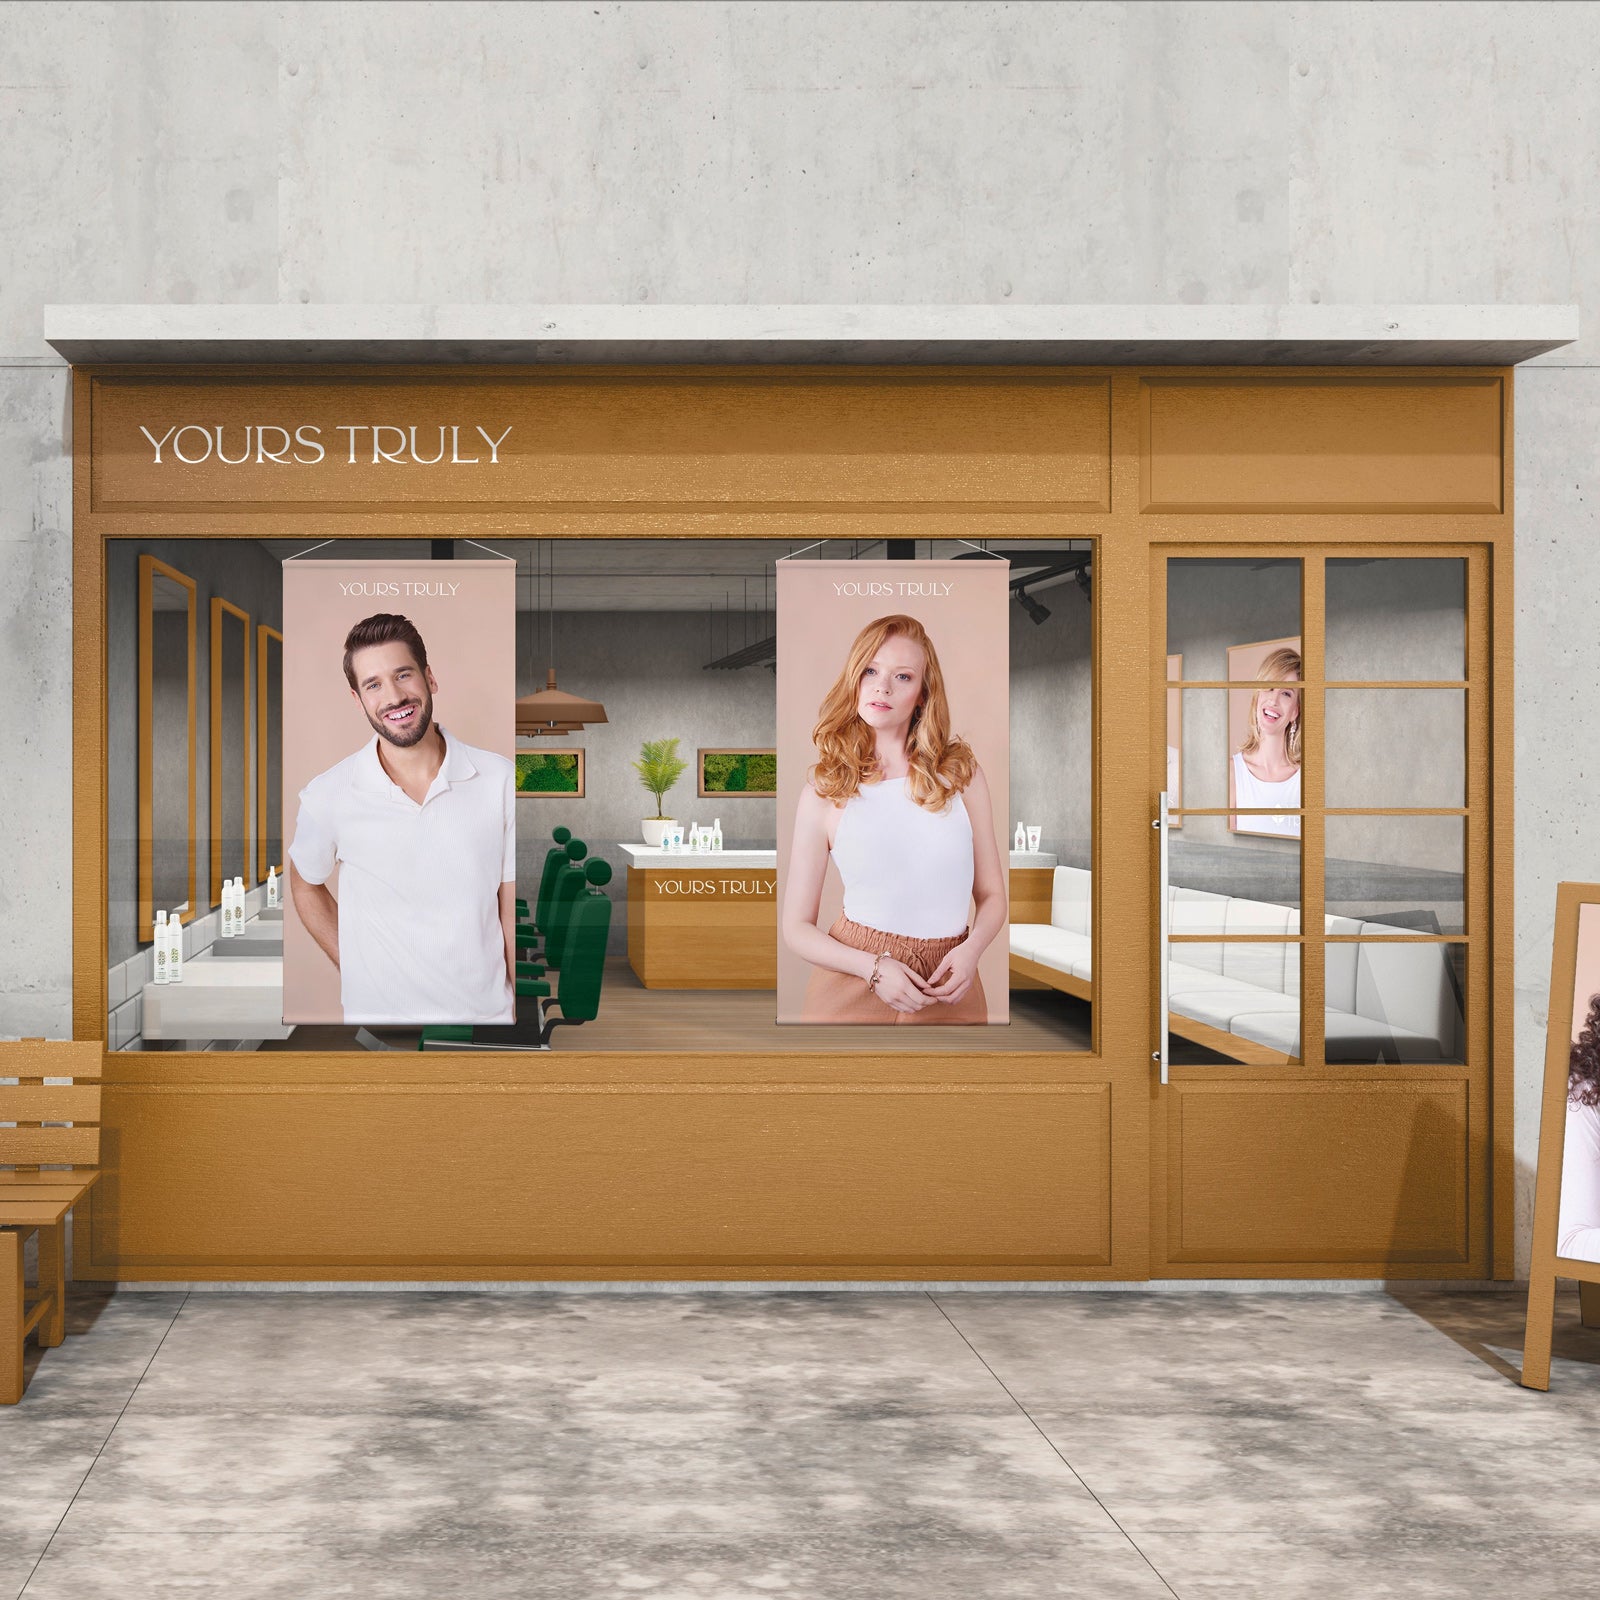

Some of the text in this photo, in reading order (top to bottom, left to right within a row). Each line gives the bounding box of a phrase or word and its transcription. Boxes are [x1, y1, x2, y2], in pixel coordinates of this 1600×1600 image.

[139, 425, 513, 464] YOURS TRULY
[339, 582, 460, 596] YOURS TRULY
[832, 582, 954, 596] YOURS TRULY
[654, 880, 777, 895] YOURS TRULY
